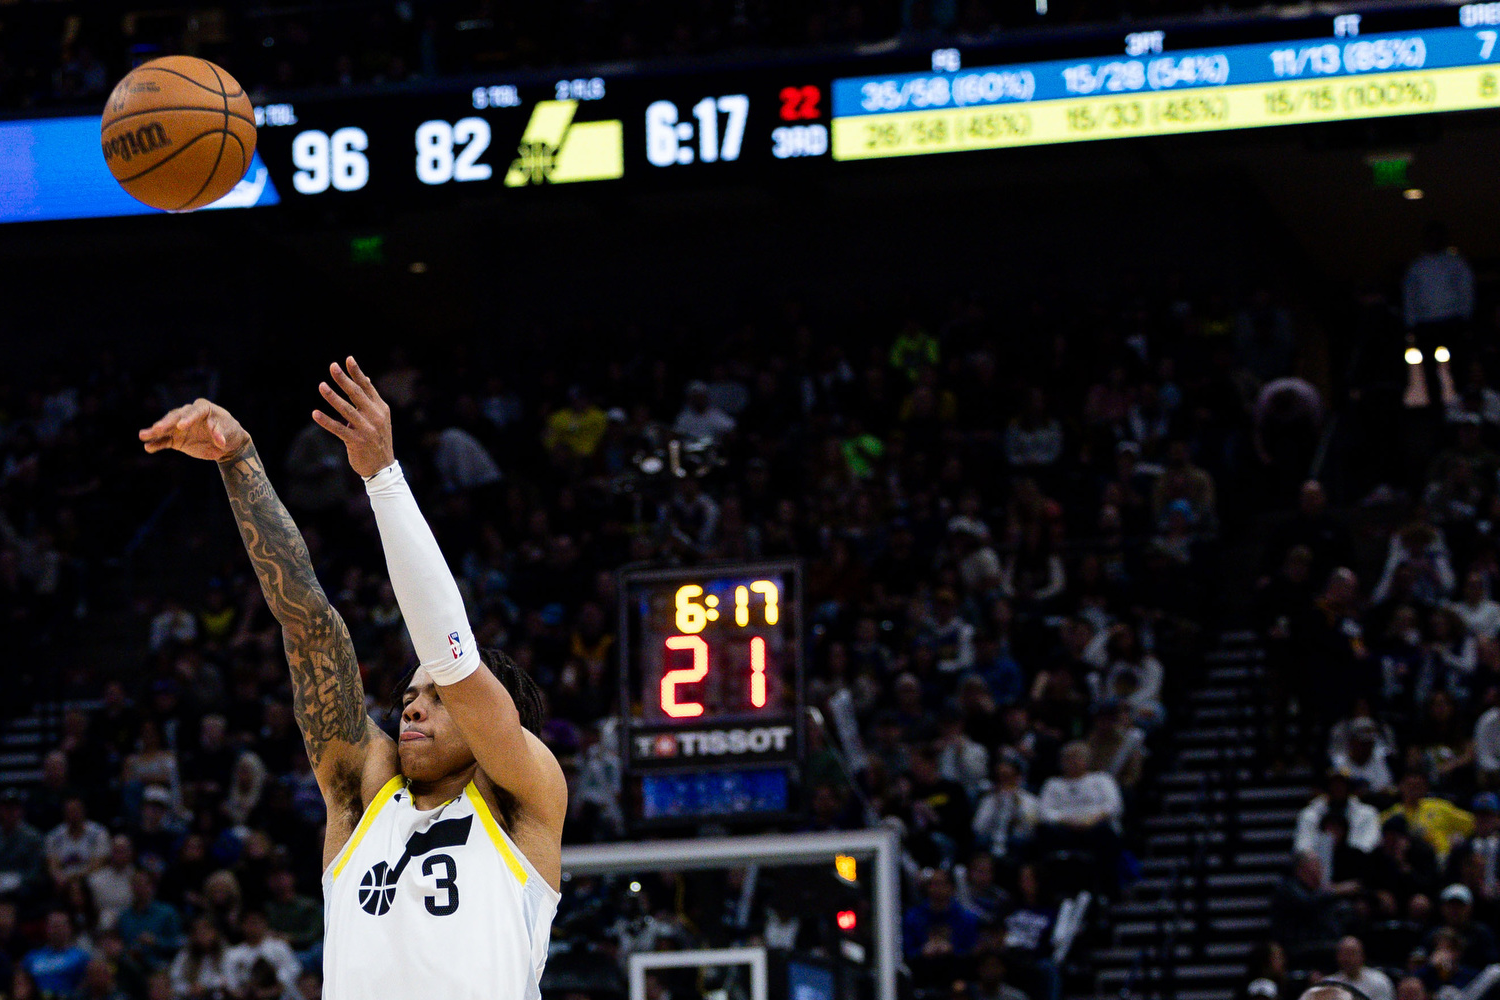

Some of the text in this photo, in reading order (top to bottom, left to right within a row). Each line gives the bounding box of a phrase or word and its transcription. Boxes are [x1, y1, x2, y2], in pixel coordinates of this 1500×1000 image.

[645, 94, 750, 168] 6:17
[779, 85, 821, 121] 22
[291, 126, 370, 195] 96
[414, 116, 493, 185] 82
[675, 580, 779, 634] 6:17
[660, 634, 767, 718] 21
[675, 726, 793, 757] TISSOT
[421, 853, 460, 917] 3
